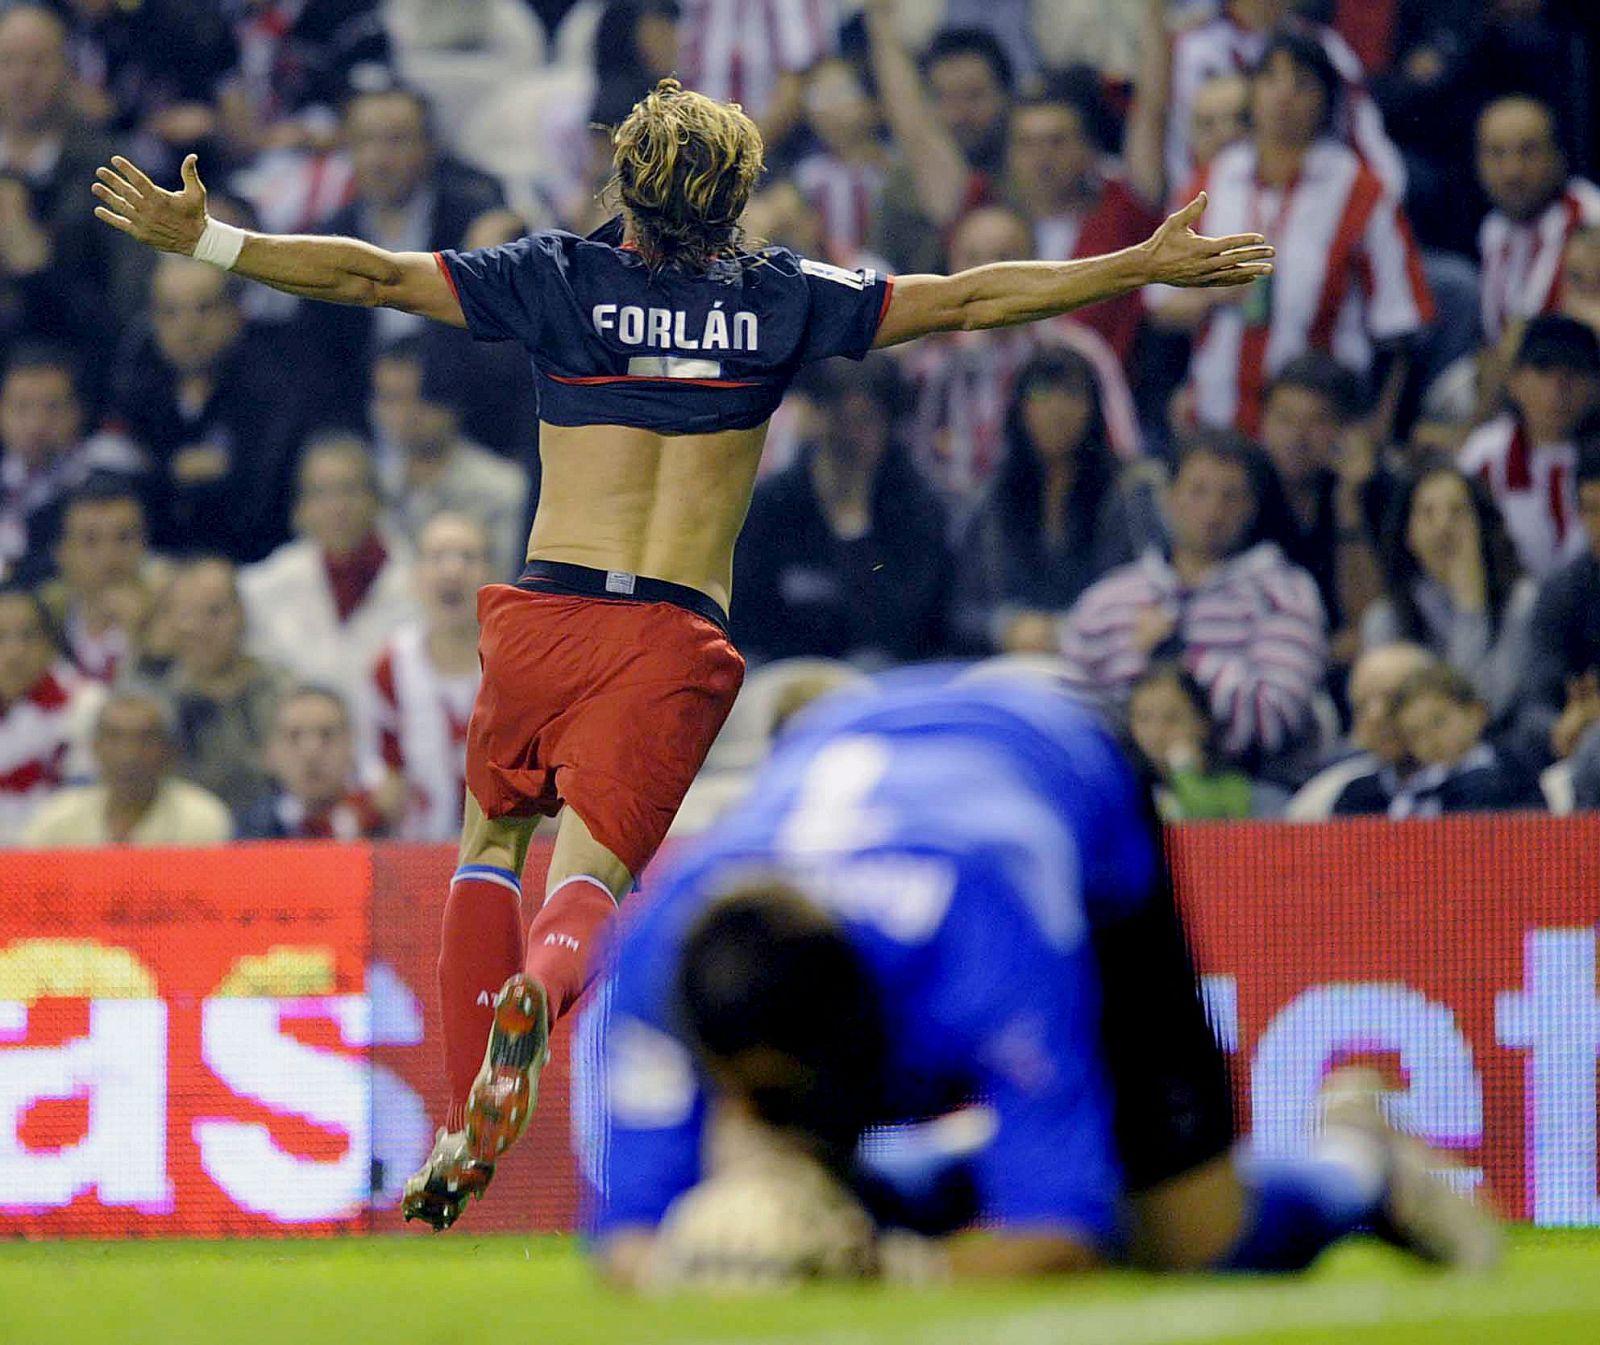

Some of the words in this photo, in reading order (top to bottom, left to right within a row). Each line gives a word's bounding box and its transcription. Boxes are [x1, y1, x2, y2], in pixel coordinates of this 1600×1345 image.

[592, 301, 758, 350] FORLÁN
[545, 933, 579, 951] ATM
[477, 990, 502, 1008] AT
